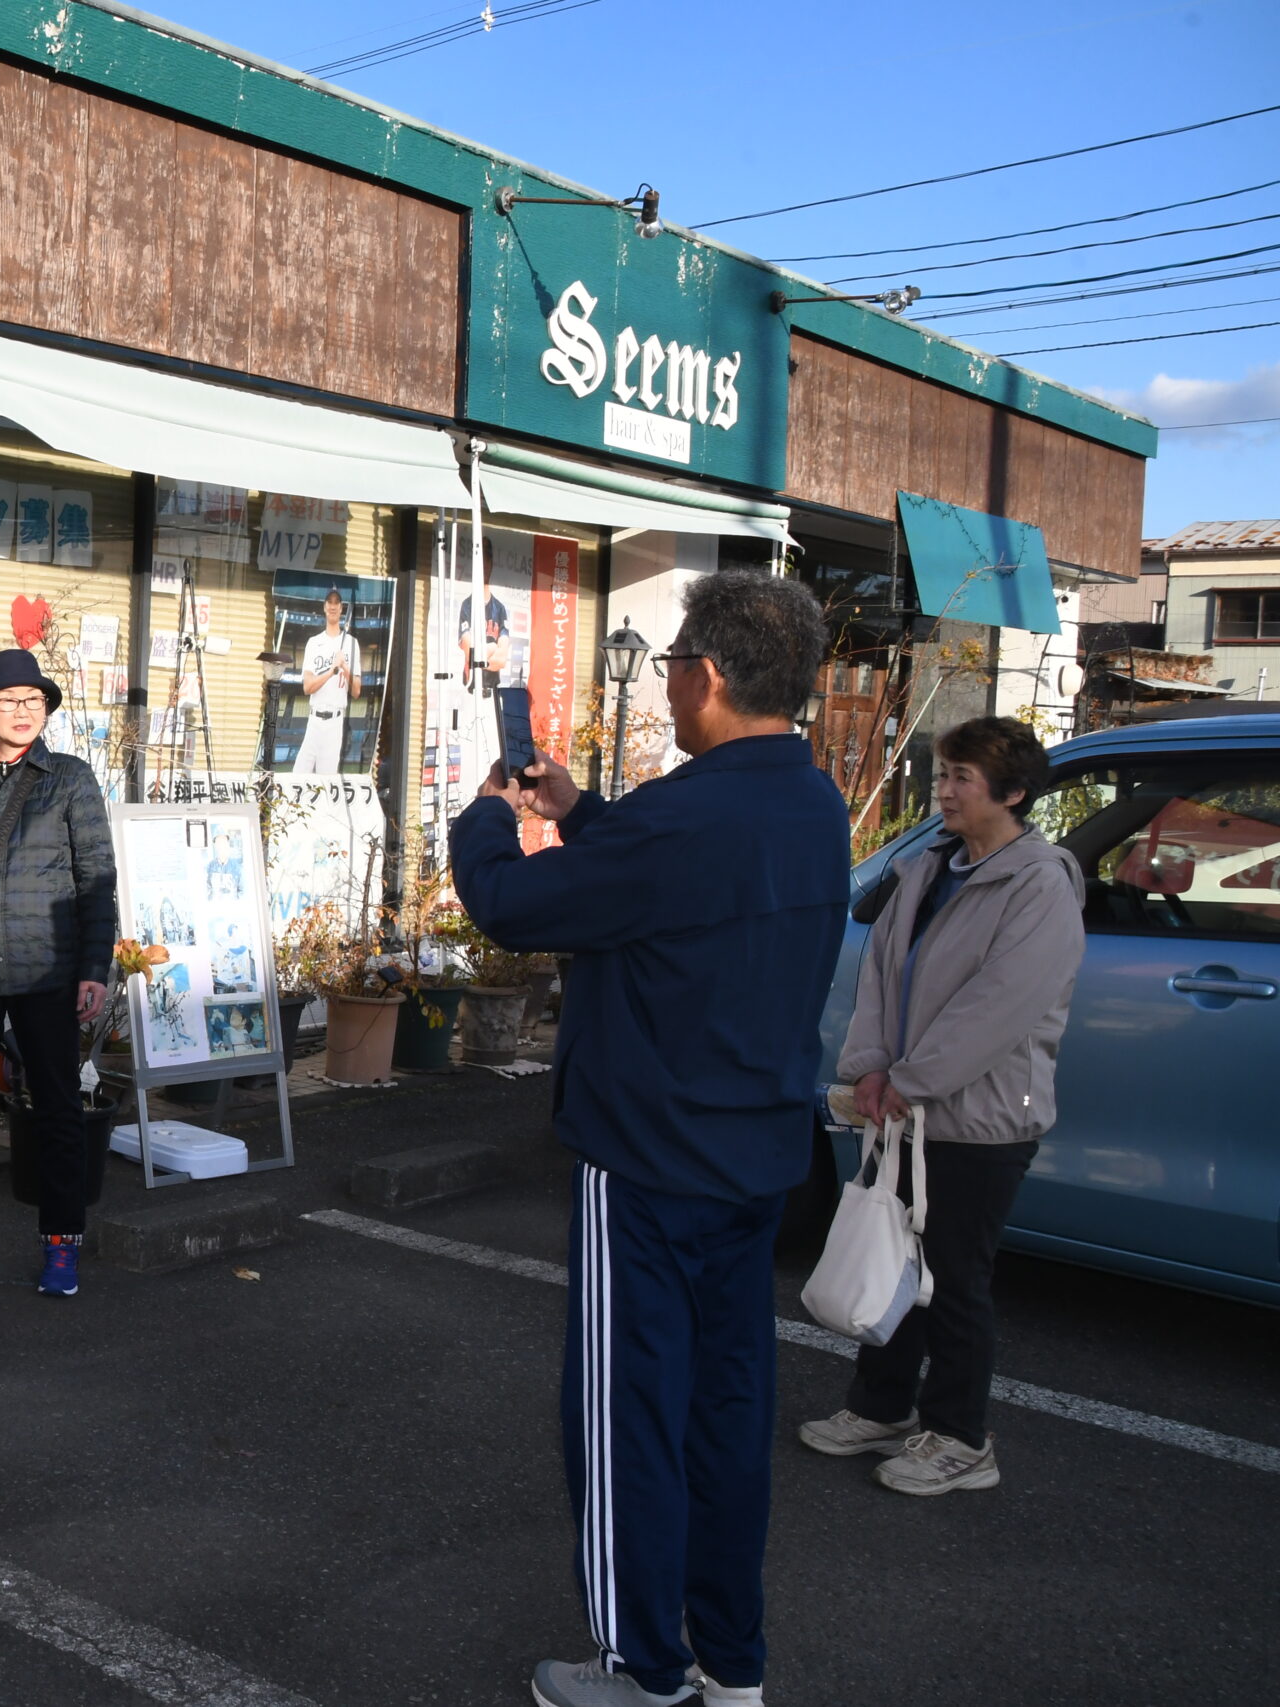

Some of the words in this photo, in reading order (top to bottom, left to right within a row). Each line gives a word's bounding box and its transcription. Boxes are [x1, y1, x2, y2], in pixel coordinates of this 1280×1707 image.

[540, 280, 741, 431] Seems
[610, 407, 640, 441] hair
[644, 418, 656, 446] &
[663, 431, 686, 457] spa
[260, 529, 321, 562] MVP
[153, 561, 177, 584] HR
